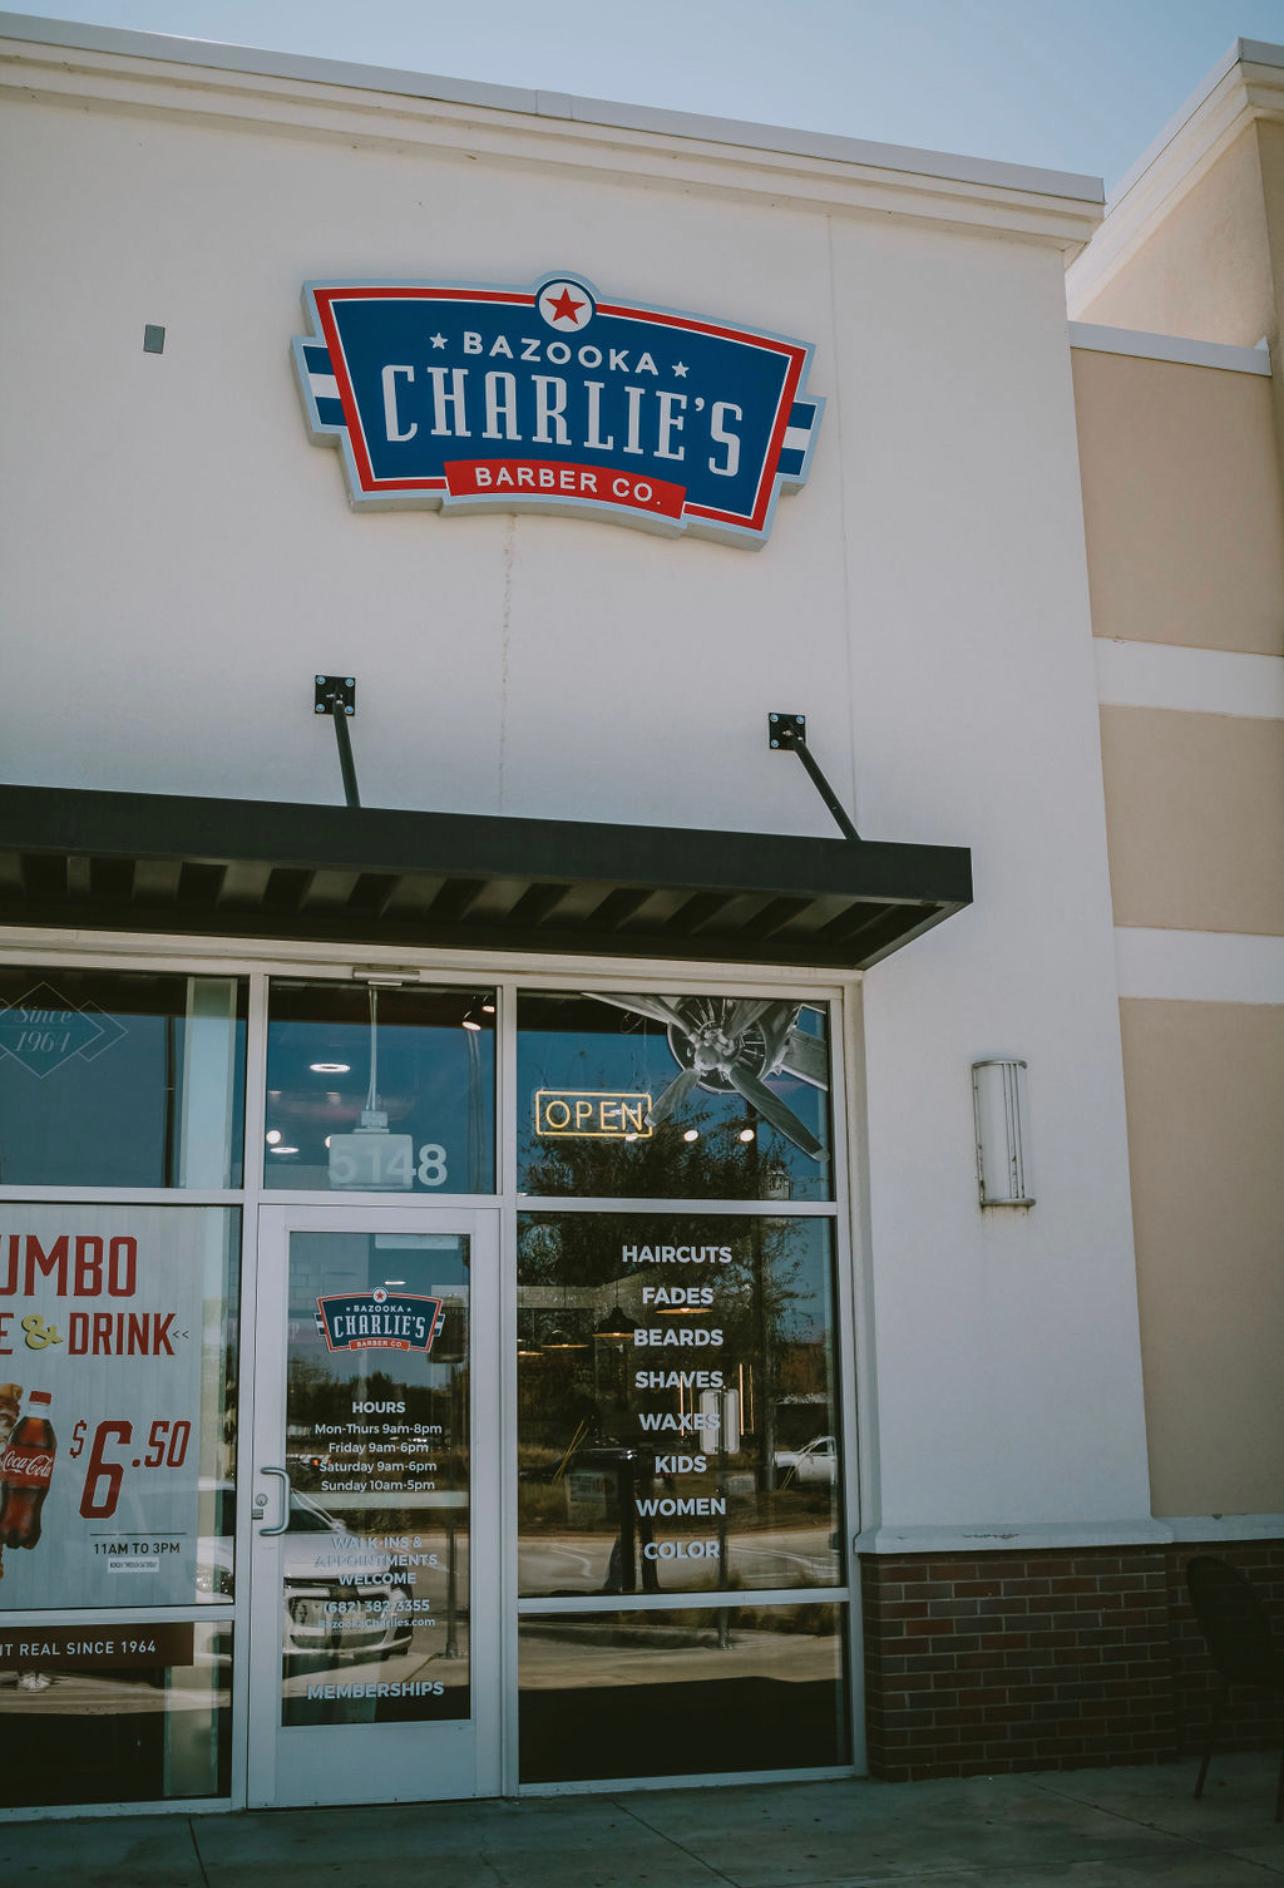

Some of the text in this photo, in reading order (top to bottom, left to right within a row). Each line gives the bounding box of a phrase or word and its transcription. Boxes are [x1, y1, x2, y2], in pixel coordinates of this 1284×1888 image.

[463, 331, 659, 376] BAZOOKA
[381, 364, 743, 477] CHARLIE'S
[475, 466, 661, 505] BARBER CO.
[17, 1005, 74, 1023] Since
[546, 1100, 643, 1131] OPEN
[329, 1143, 448, 1186] 5148
[622, 1245, 732, 1264] HAIRCUTS
[642, 1287, 714, 1305] FADES
[353, 1305, 404, 1313] BAZOOKA
[21, 1313, 63, 1351] &
[68, 1312, 176, 1356] DRINK
[333, 1314, 426, 1338] CHARLIE'S
[357, 1340, 388, 1348] BARBER
[633, 1328, 724, 1347] BEARDS
[635, 1371, 723, 1389] SHAVES
[352, 1401, 406, 1415] HOURS
[314, 1423, 442, 1436] Mon-Thurs 9am-8pm
[639, 1413, 721, 1431] WAXES
[329, 1442, 429, 1455] Friday 9am-6pm
[69, 1419, 192, 1519] $6.50
[319, 1461, 437, 1473] Saturday 9am-6pm
[655, 1455, 707, 1473] KIDS
[321, 1480, 435, 1492] Sunday 10am-5pm
[635, 1498, 727, 1517] WOMEN
[94, 1542, 180, 1554] 11AM TO 3PM
[413, 1536, 422, 1548] &
[643, 1541, 721, 1560] COLOR
[339, 1572, 417, 1586] WELCOME
[19, 1642, 61, 1656] REAL
[66, 1641, 114, 1655] SINCE
[121, 1640, 156, 1654] 1964
[307, 1681, 445, 1700] MEMBERSHIPS
